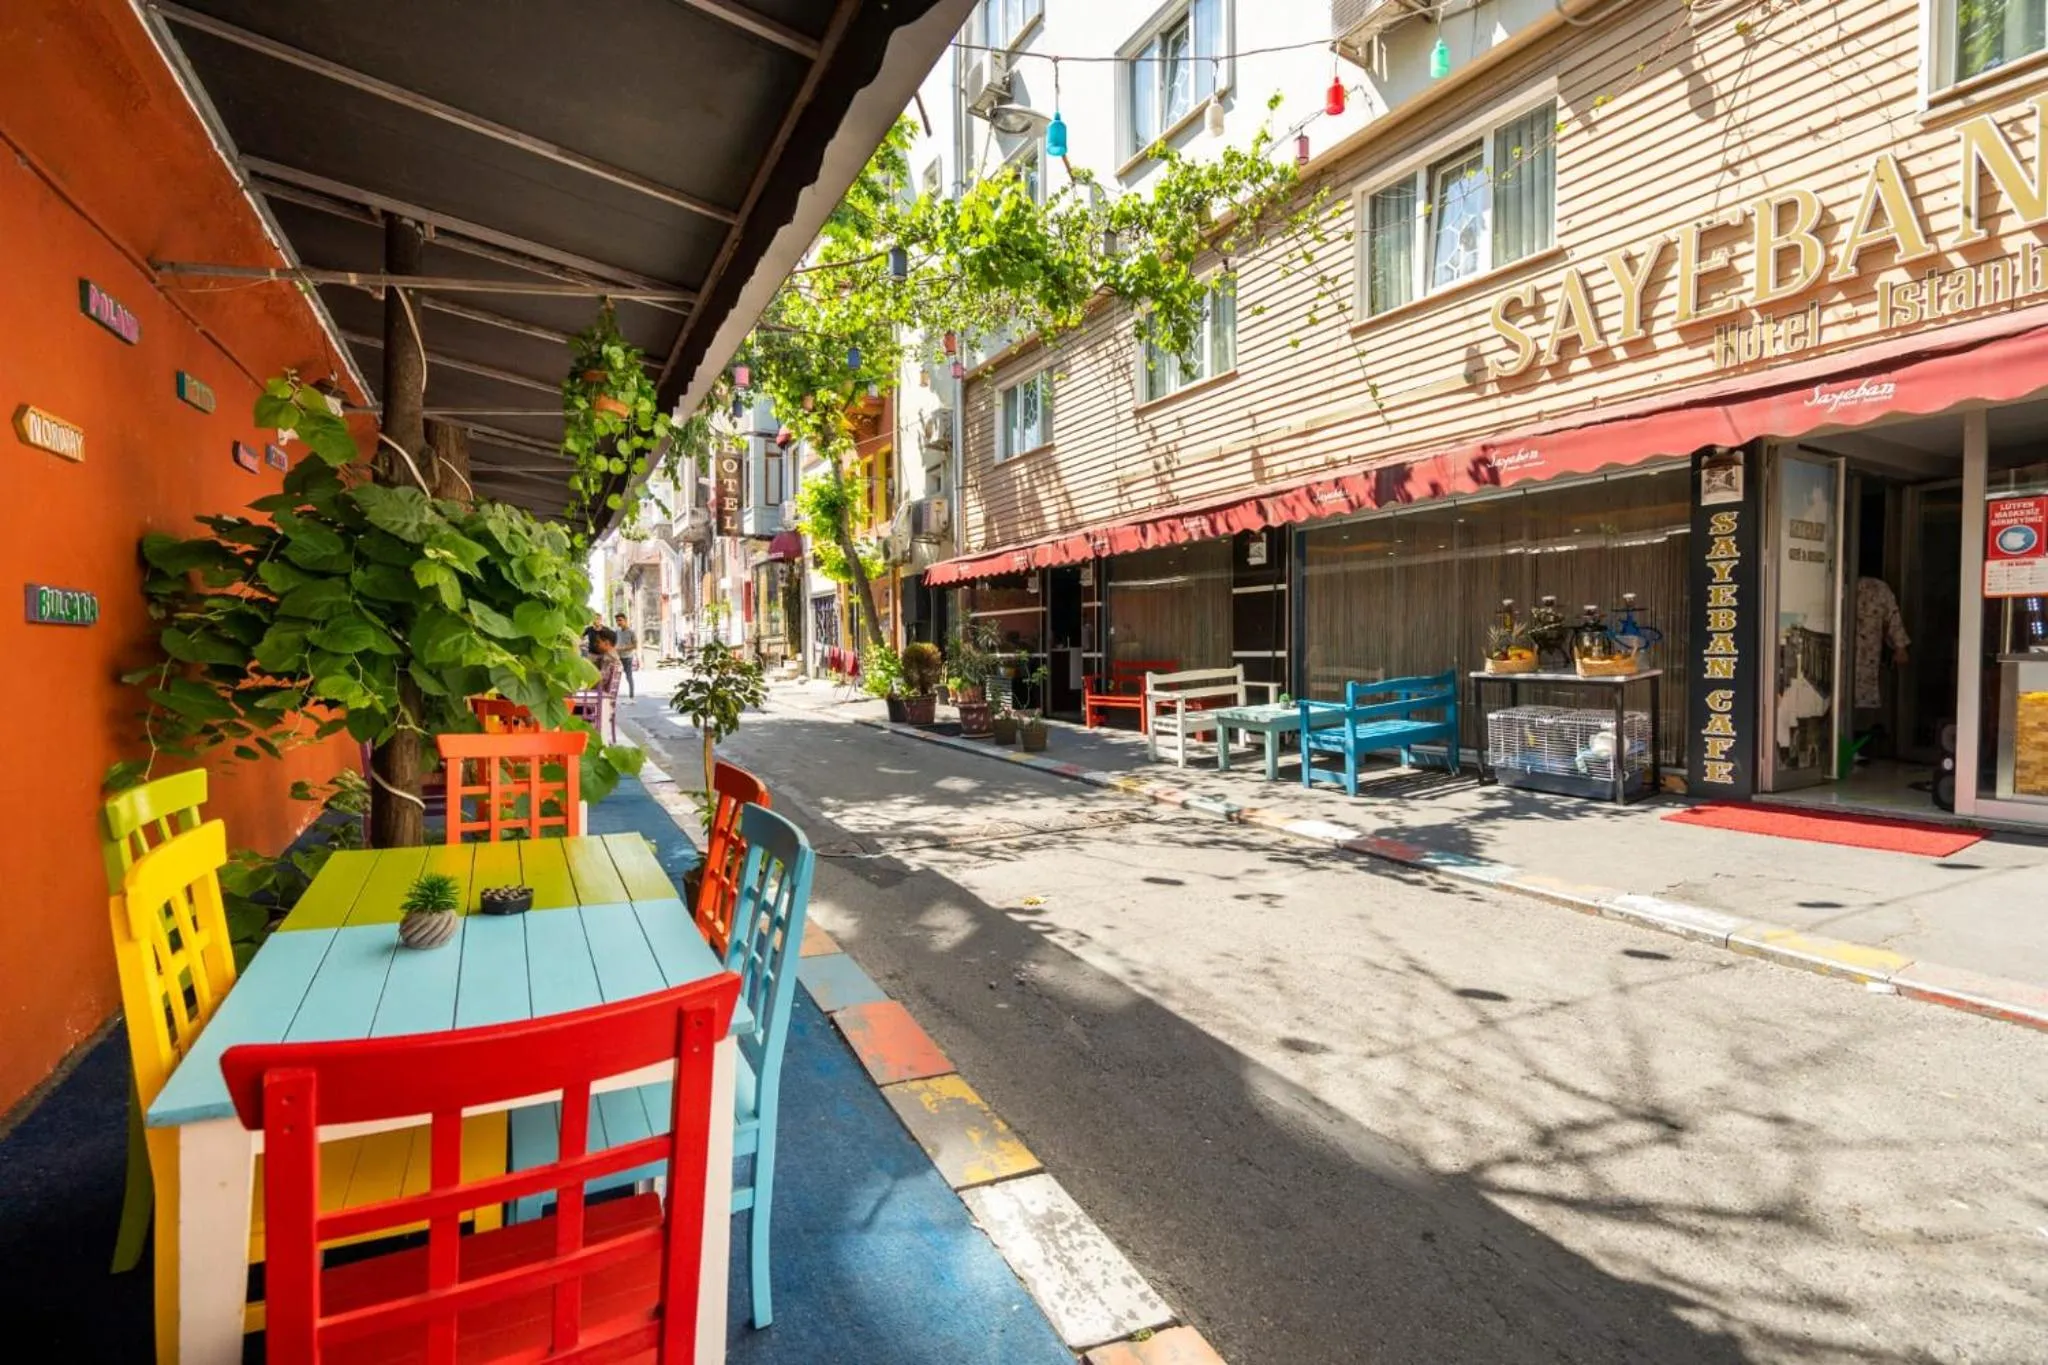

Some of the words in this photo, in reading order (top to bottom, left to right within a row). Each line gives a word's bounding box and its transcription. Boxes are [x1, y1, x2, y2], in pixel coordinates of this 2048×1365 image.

[1488, 91, 2048, 378] SAYEBAN
[1713, 300, 1820, 368] Hotel
[1704, 511, 1741, 679] SAYEBAN
[1702, 689, 1737, 784] CAFE
